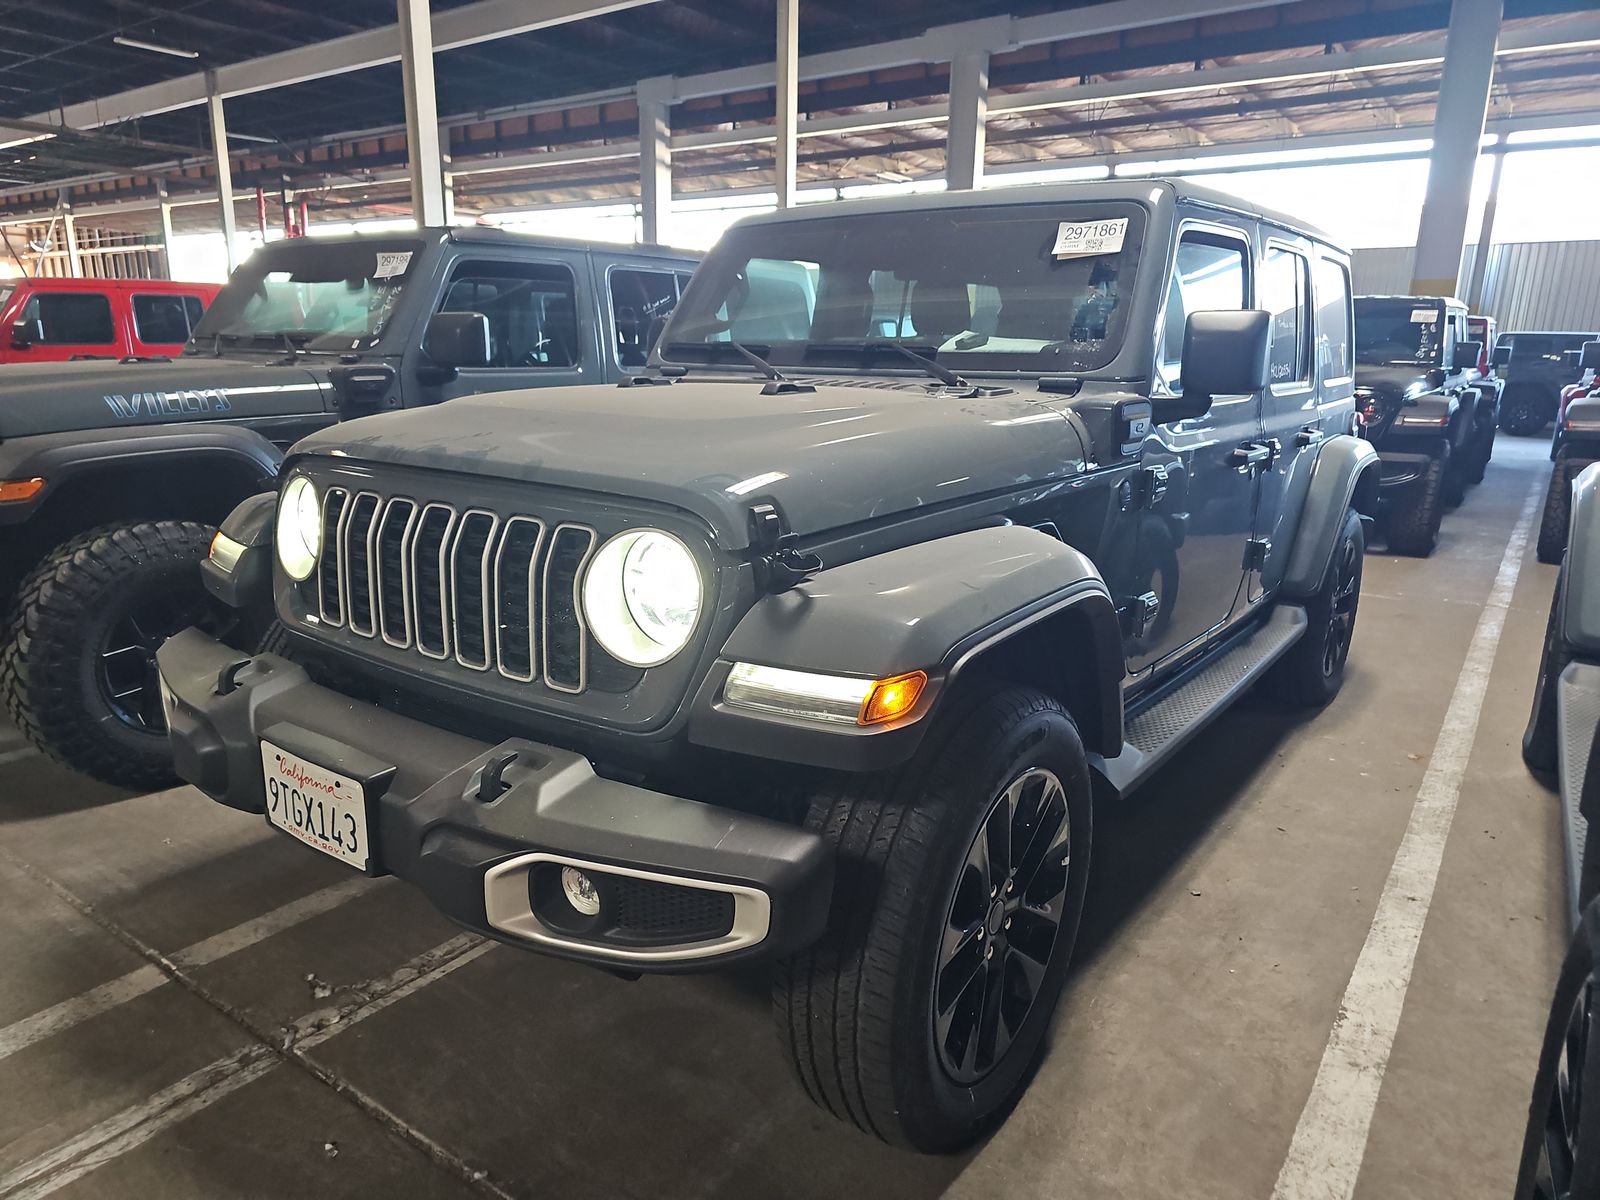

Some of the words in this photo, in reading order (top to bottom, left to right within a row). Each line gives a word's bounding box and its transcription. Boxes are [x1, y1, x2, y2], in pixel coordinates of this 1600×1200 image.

[1064, 222, 1125, 240] 2971861
[103, 387, 232, 418] WILLYS
[279, 757, 342, 800] California
[269, 776, 358, 853] 9TGX143
